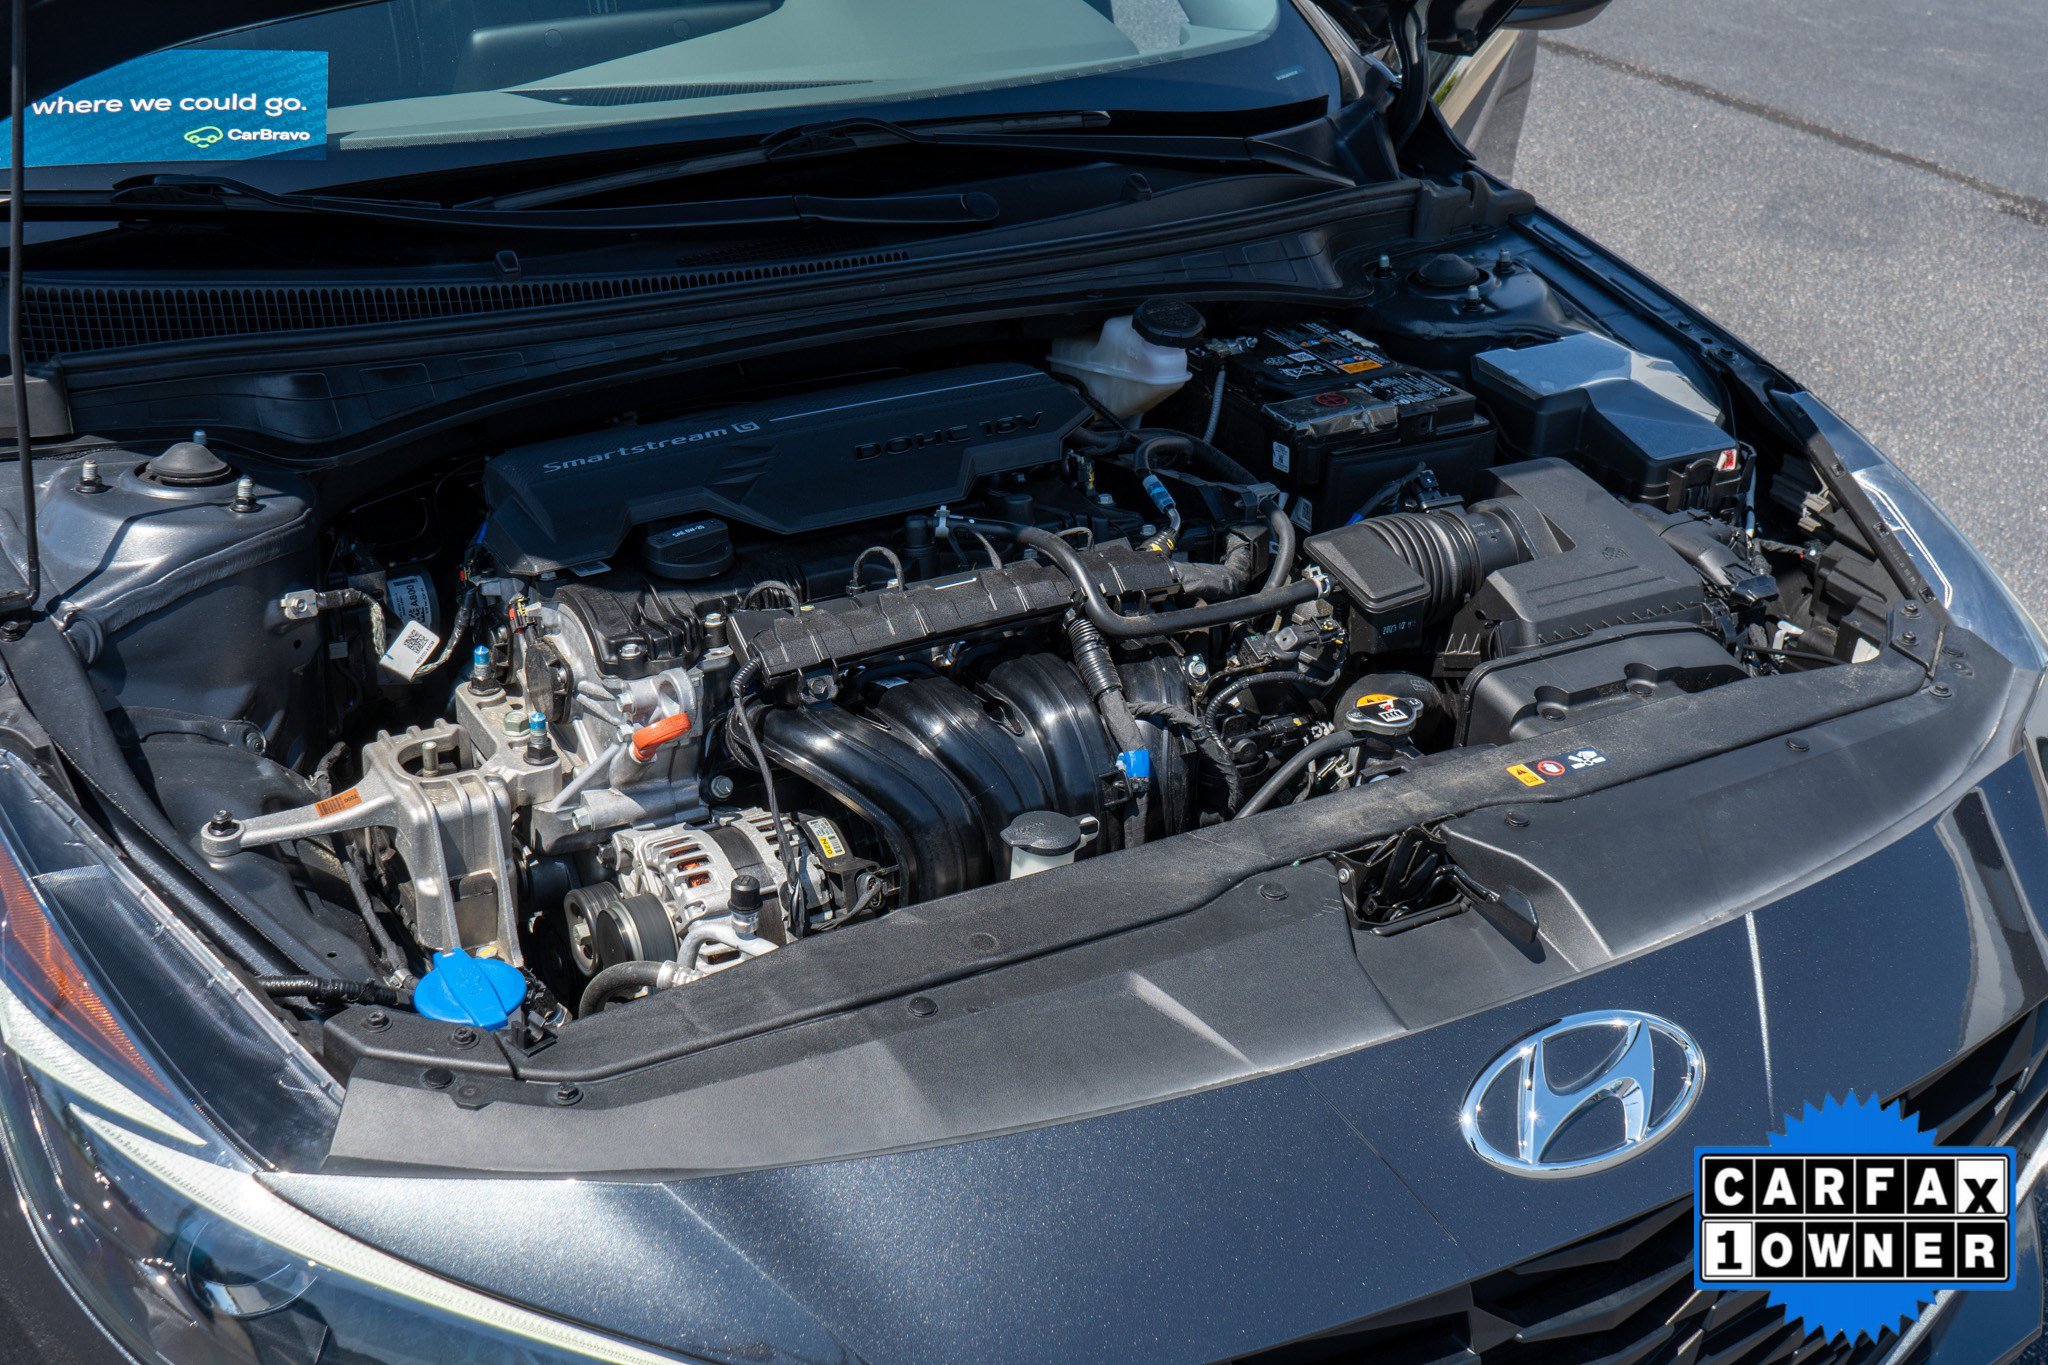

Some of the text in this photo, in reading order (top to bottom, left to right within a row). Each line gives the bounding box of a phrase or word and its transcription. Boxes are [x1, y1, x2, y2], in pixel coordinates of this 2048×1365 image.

[124, 68, 185, 93] CarBravo
[200, 66, 262, 90] CarBravo
[234, 66, 296, 91] CarBravo
[31, 92, 307, 117] where we could go.
[227, 128, 311, 141] CarBravo
[855, 411, 1045, 461] DOHC 16V
[543, 428, 728, 474] Smartstream
[407, 585, 419, 607] A800
